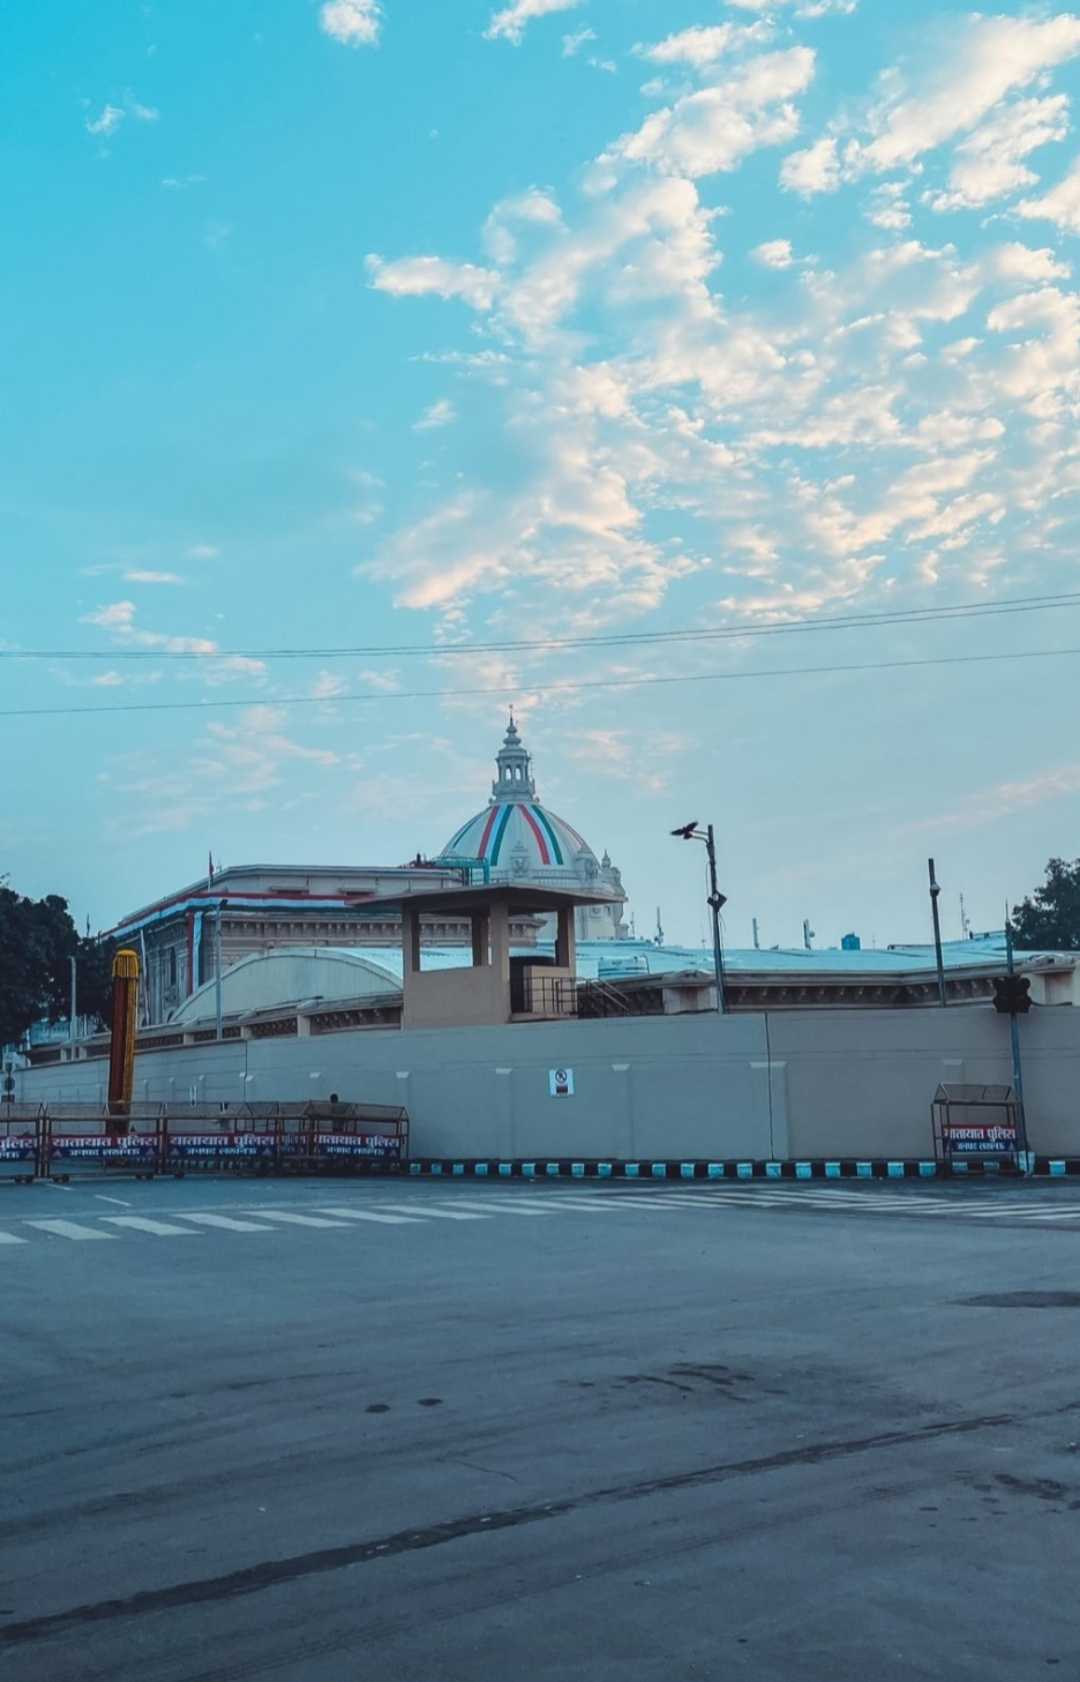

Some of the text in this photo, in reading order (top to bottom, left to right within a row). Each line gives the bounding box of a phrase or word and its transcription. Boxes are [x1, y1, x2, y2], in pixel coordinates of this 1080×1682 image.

[169, 1136, 229, 1146] यातायात
[234, 1133, 275, 1149] पुलिस
[987, 1126, 1016, 1142] पुलिस
[52, 1135, 158, 1149] यातायात पुलिस
[366, 1135, 400, 1149] पुलिस
